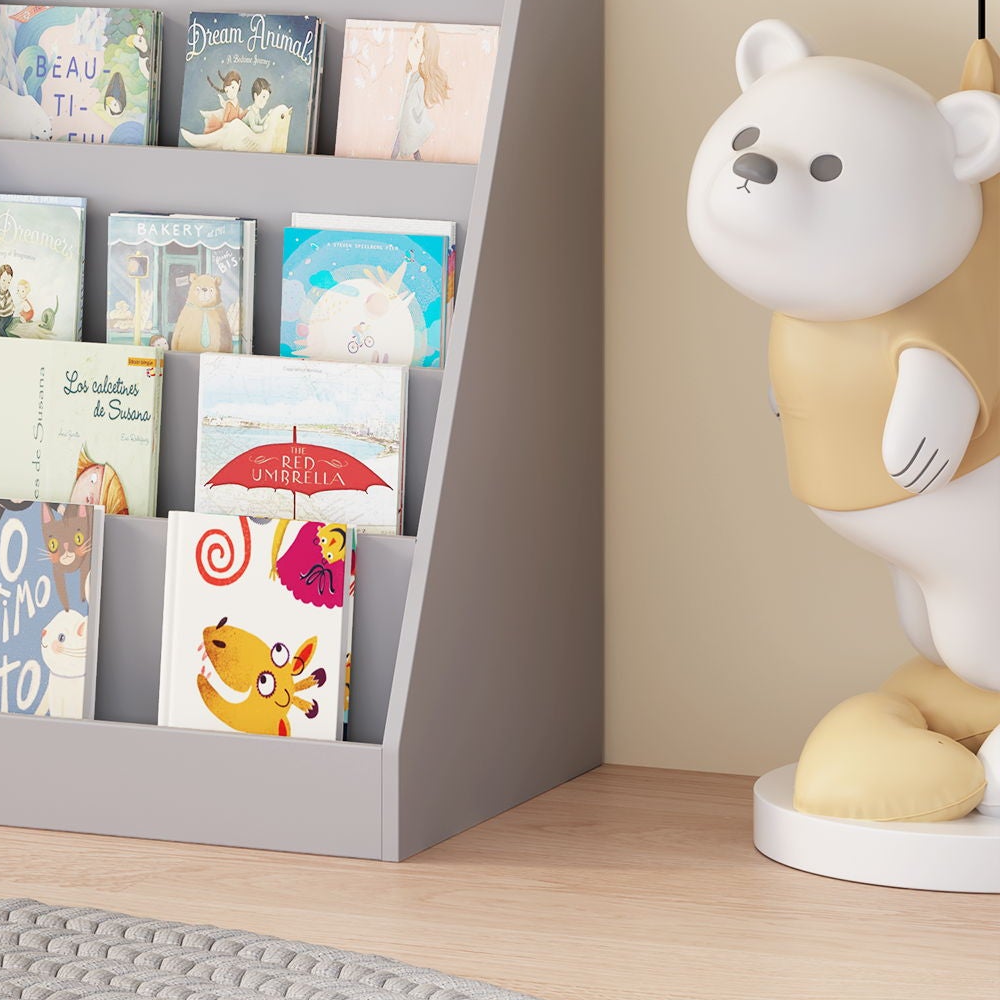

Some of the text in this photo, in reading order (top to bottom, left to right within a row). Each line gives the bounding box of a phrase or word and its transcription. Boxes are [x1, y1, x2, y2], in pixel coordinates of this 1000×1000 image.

[186, 14, 314, 66] Dream Animals
[53, 94, 88, 116] TI-
[137, 222, 204, 237] BAKERY
[63, 370, 139, 397] Los calcetines
[33, 366, 45, 443] Susana
[93, 399, 152, 421] de Susana
[290, 446, 307, 455] THE
[281, 455, 315, 471] RED
[251, 469, 346, 486] UMBRELLA
[0, 517, 28, 583] O
